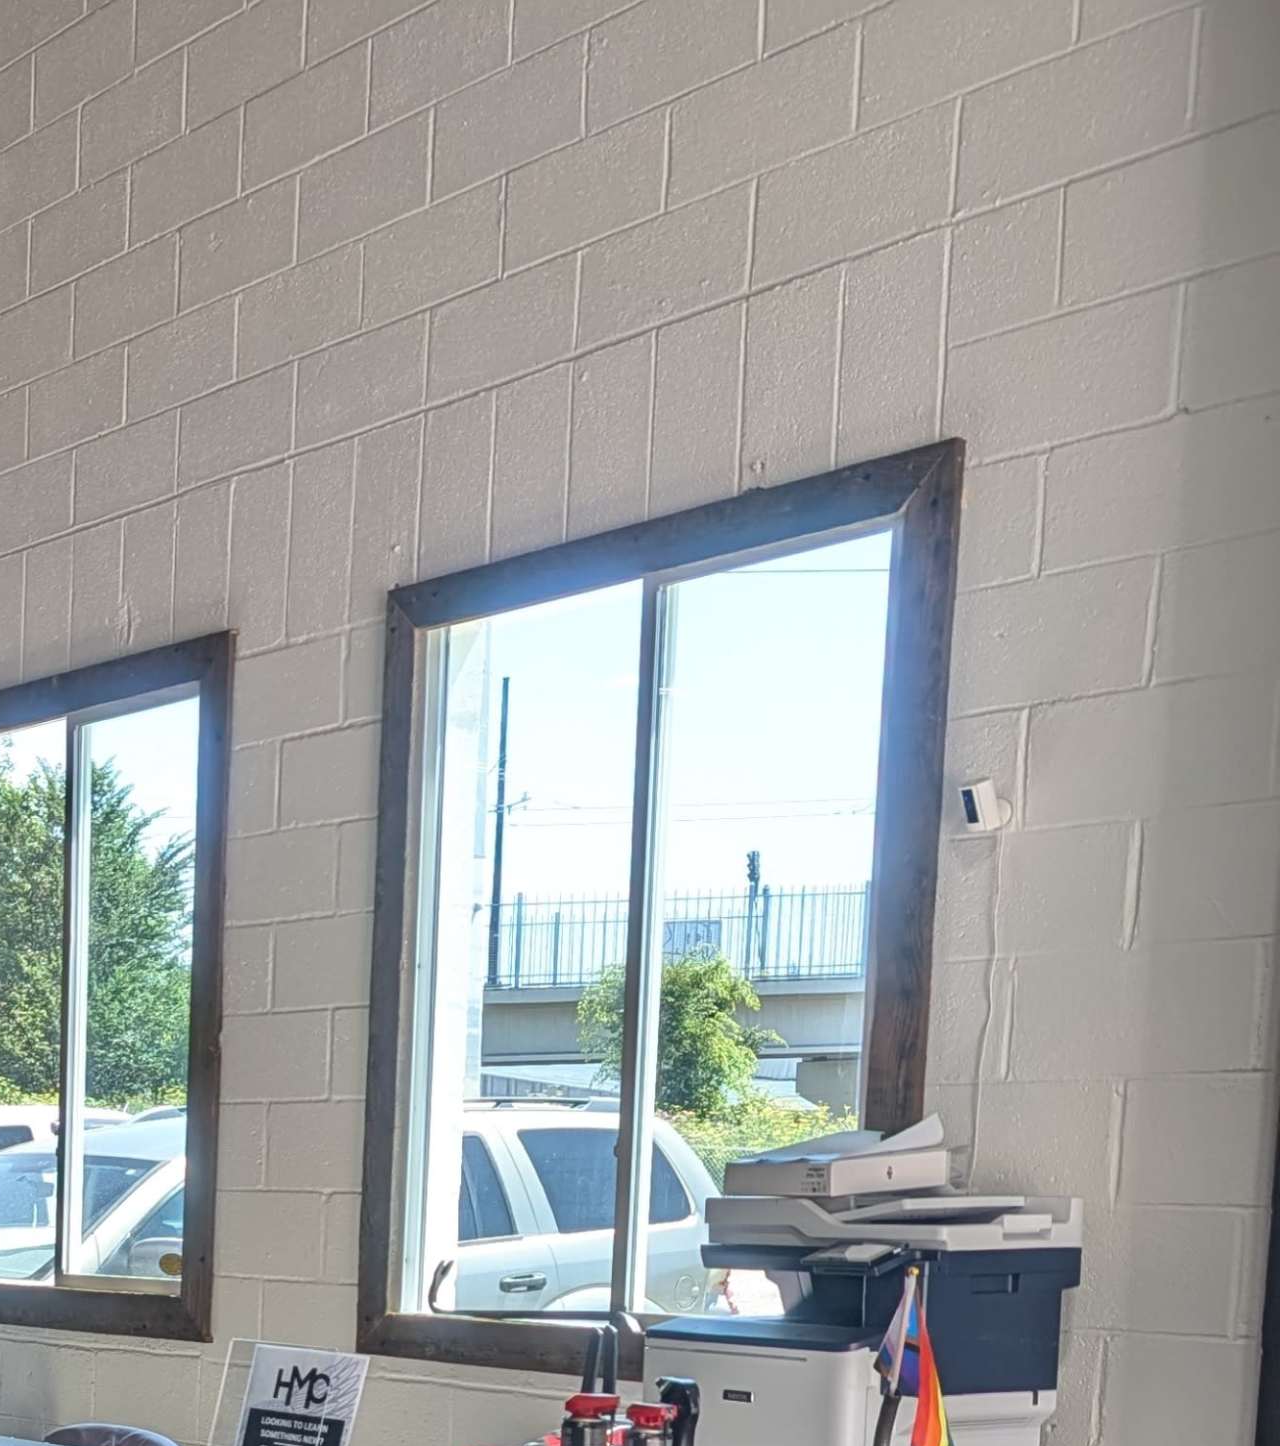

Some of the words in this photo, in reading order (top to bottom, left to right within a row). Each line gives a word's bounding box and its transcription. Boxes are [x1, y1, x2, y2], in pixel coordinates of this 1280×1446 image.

[272, 1365, 331, 1410] HMC
[260, 1416, 293, 1429] LOOKING
[293, 1420, 303, 1430] TO
[260, 1429, 302, 1442] SOMETHING
